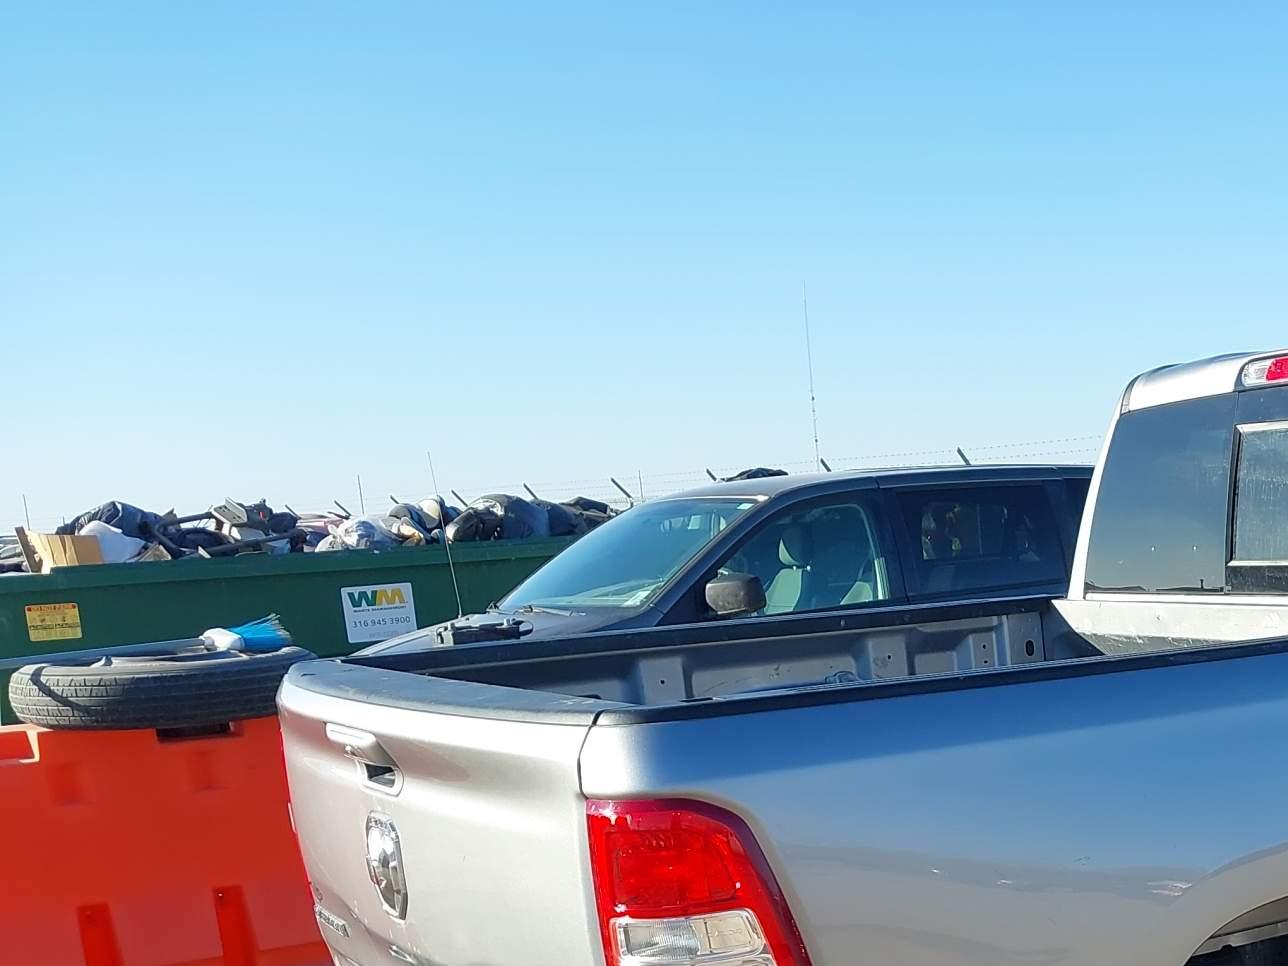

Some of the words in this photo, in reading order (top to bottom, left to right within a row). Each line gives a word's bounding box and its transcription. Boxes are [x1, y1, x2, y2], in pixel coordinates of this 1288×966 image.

[346, 588, 407, 609] WM
[352, 620, 369, 629] 316
[370, 617, 387, 627] 945
[389, 615, 412, 625] 3900
